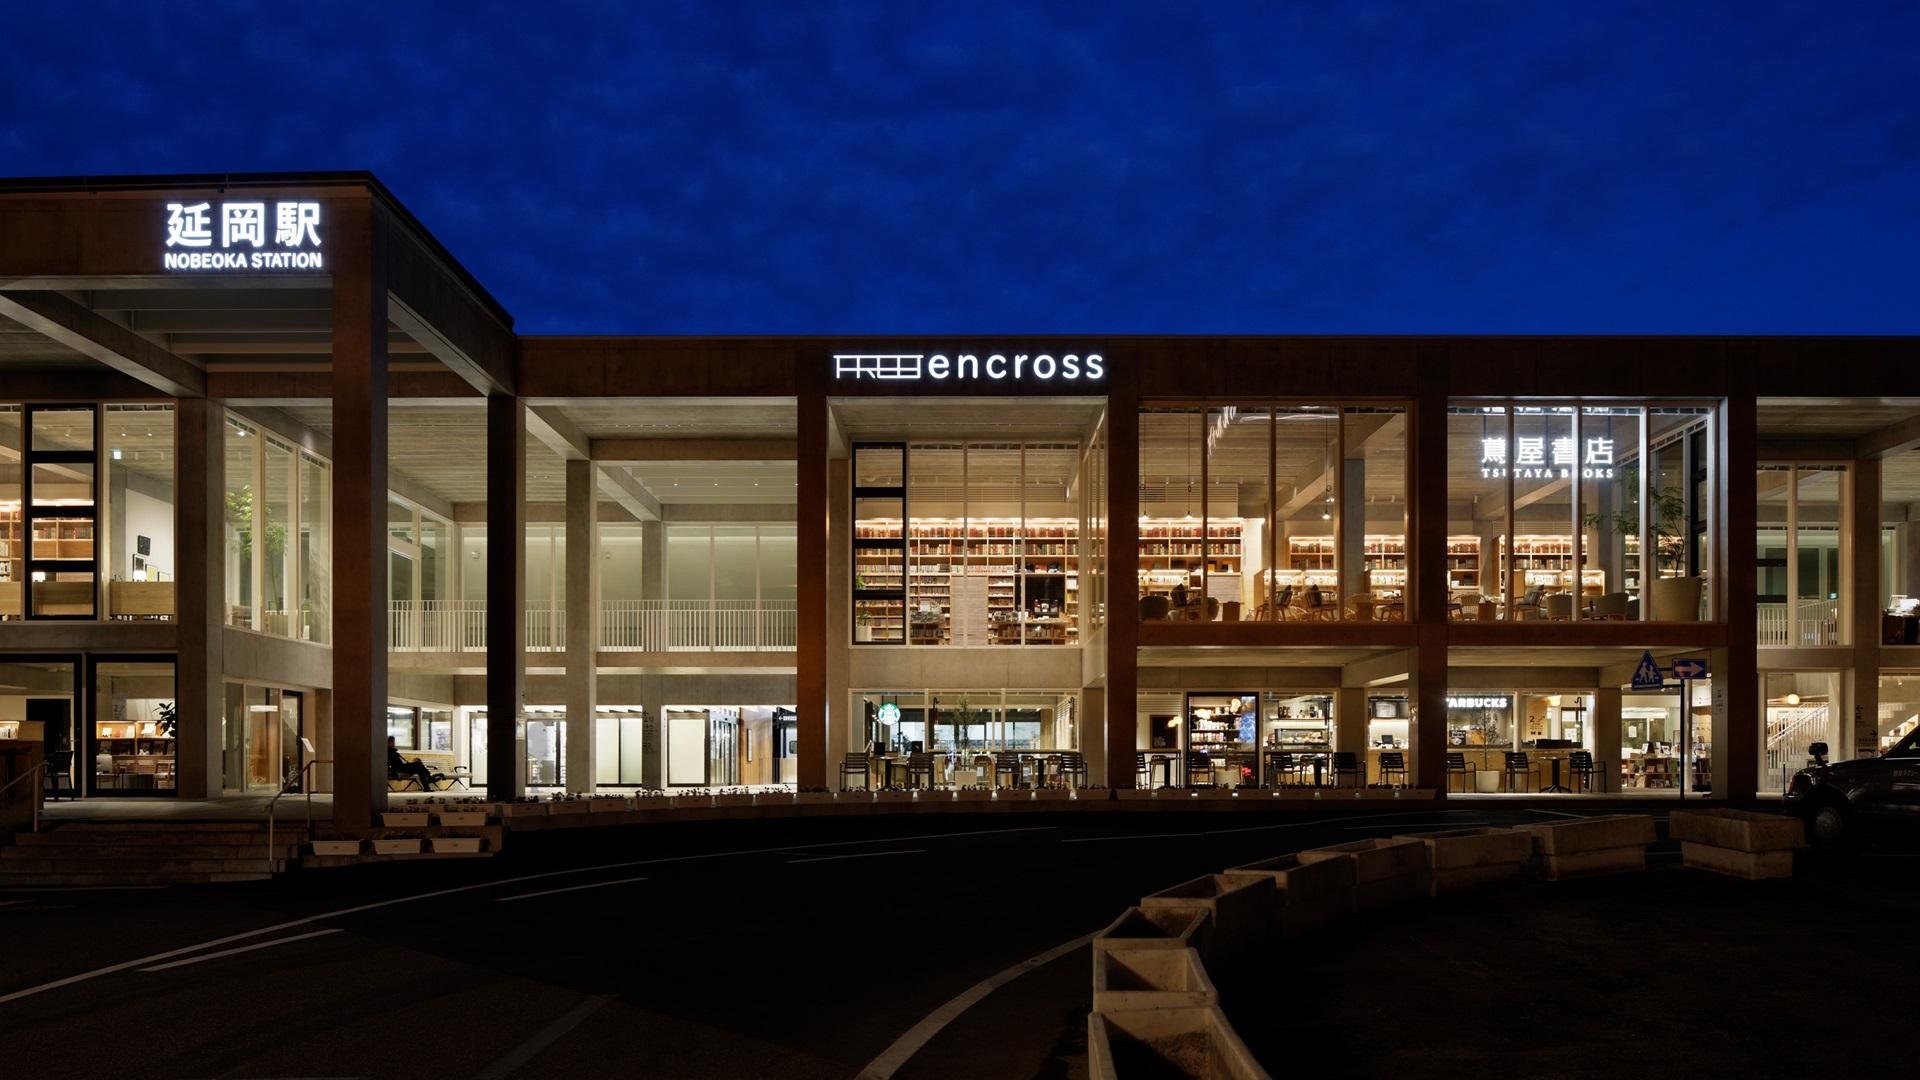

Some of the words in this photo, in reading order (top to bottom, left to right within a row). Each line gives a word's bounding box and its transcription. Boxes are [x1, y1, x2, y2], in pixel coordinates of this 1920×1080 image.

[165, 202, 322, 248] 延岡駅
[164, 252, 248, 269] NOBEOKA
[251, 252, 322, 269] STATION
[928, 354, 1104, 379] encross
[1481, 436, 1614, 465] 蔦屋書店
[1561, 468, 1613, 478] BOKS
[1446, 697, 1507, 708] ARBUCKS
